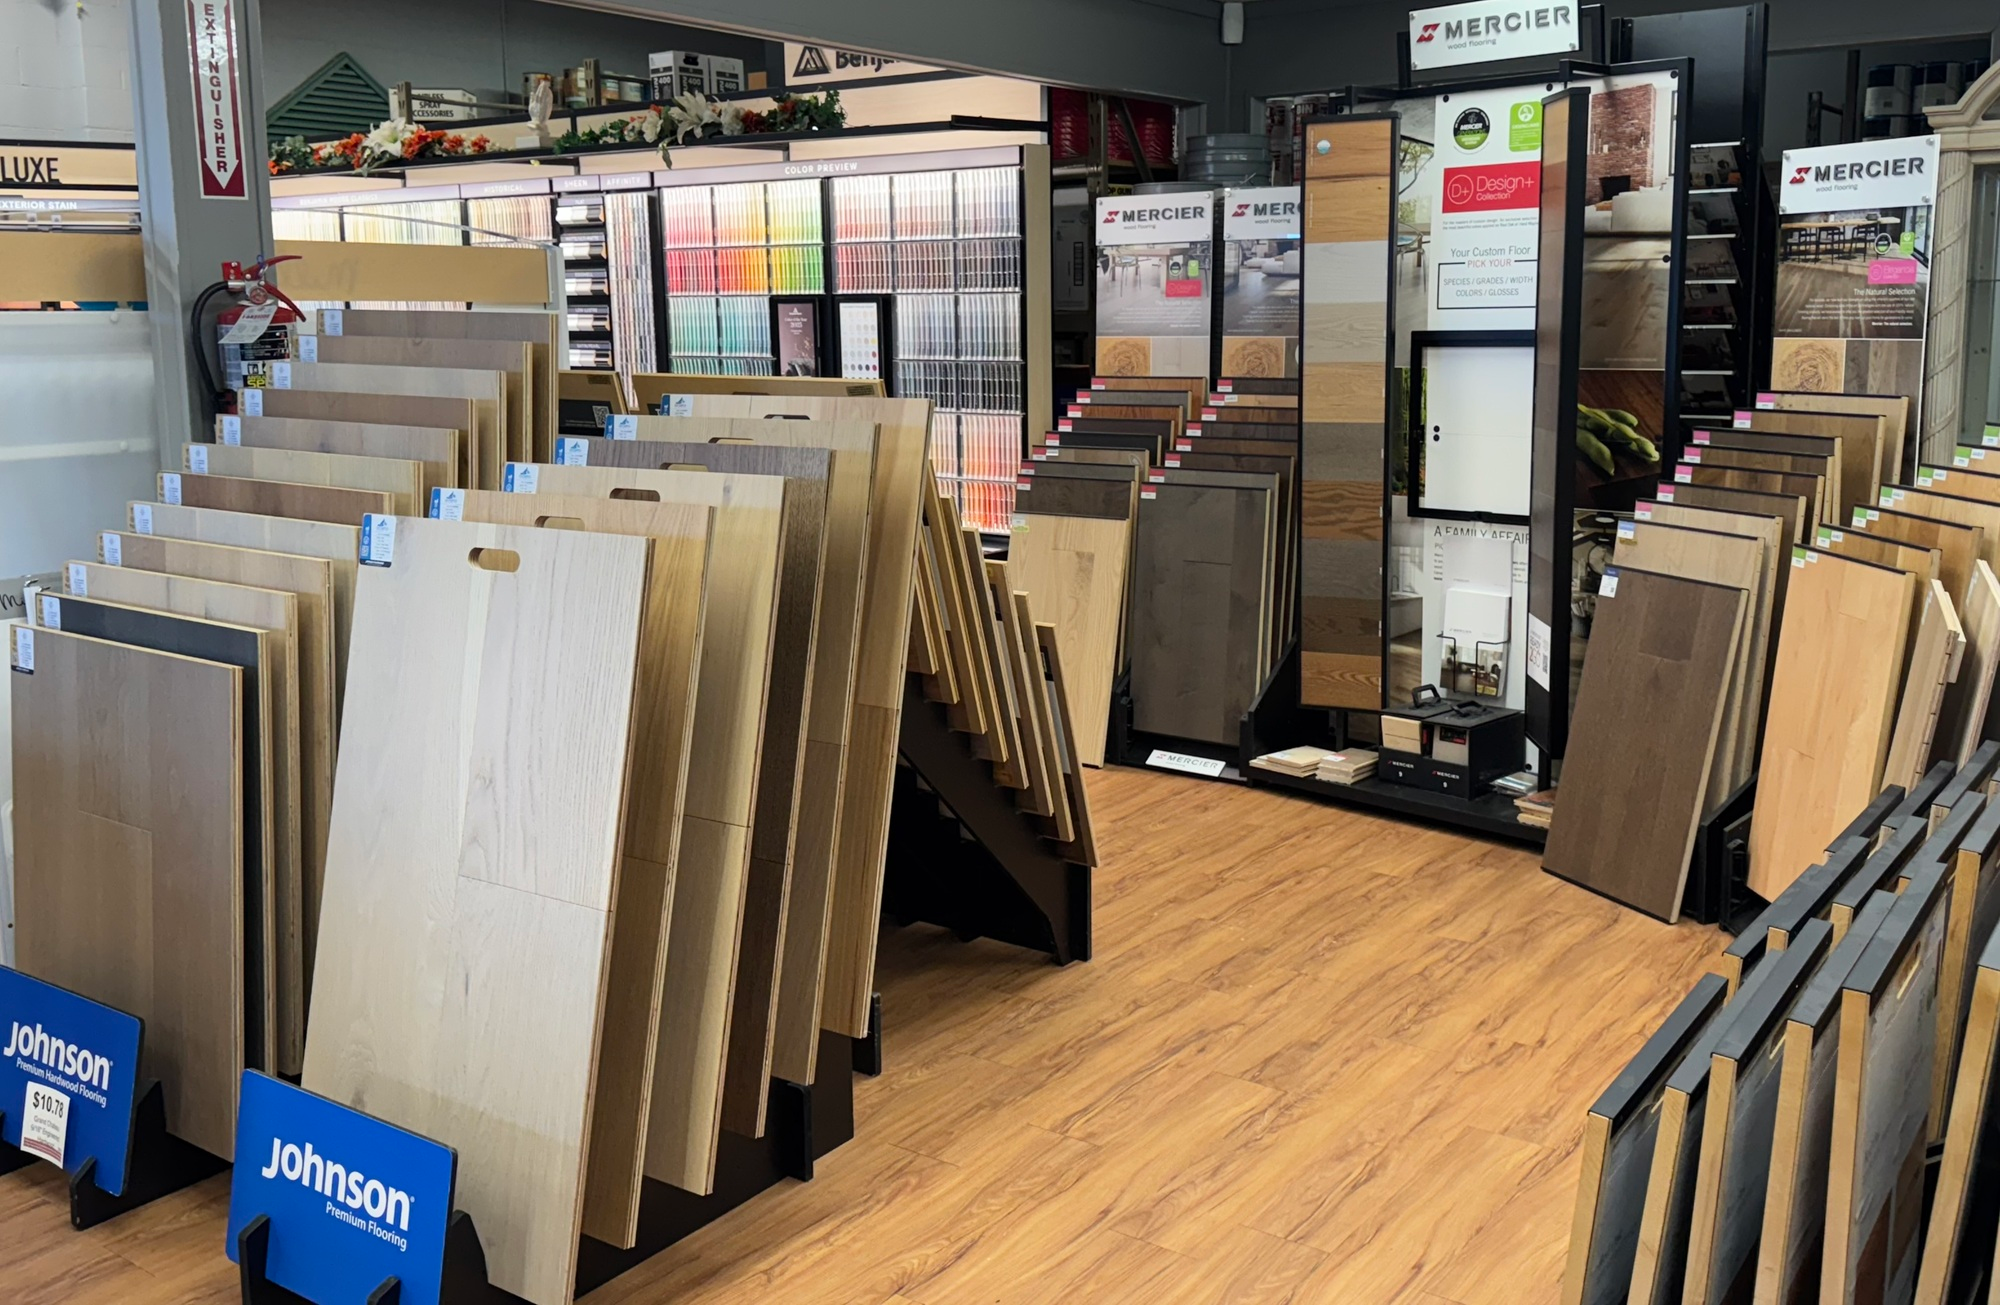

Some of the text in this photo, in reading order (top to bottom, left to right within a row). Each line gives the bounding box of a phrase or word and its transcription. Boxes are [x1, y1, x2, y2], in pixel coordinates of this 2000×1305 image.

[1445, 6, 1571, 39] MERCIER
[1447, 38, 1497, 50] wood flooring
[836, 51, 900, 73] Benj
[204, 4, 228, 173] EXTINGUISHER
[412, 110, 454, 118] CCESSORIES
[0, 156, 61, 183] LUXE
[784, 162, 858, 175] COLOR PREVIEW
[1815, 156, 1924, 182] MERCIER
[564, 180, 589, 189] SHEEN
[606, 176, 641, 187] AFFINITY
[1476, 175, 1535, 193] Design+
[1815, 182, 1858, 193] wood flooring
[484, 185, 524, 194] HISTORICAL
[1476, 192, 1511, 201] Collection
[48, 202, 78, 210] STAIN
[1122, 206, 1205, 223] MERCIER
[1451, 245, 1531, 257] Your Custom Floor
[1467, 259, 1512, 268] PICK YOUR
[1443, 278, 1471, 286] SPECIES
[1476, 277, 1504, 285] GRADES
[1510, 276, 1534, 284] WIDTH
[1455, 289, 1483, 297] COLORS
[1488, 288, 1519, 296] GLOSSES
[1888, 288, 1916, 296] Selection
[1434, 526, 1442, 537] A
[1167, 755, 1218, 769] MERCIER
[1392, 761, 1414, 769] MERCIER
[1436, 771, 1460, 779] MERCIER
[4, 1021, 110, 1091] Johnson
[16, 1057, 107, 1108] Premium Hardwood Flooring
[33, 1091, 64, 1118] $10.78
[262, 1137, 411, 1232] Johnson
[325, 1201, 407, 1252] Premium Flooring
